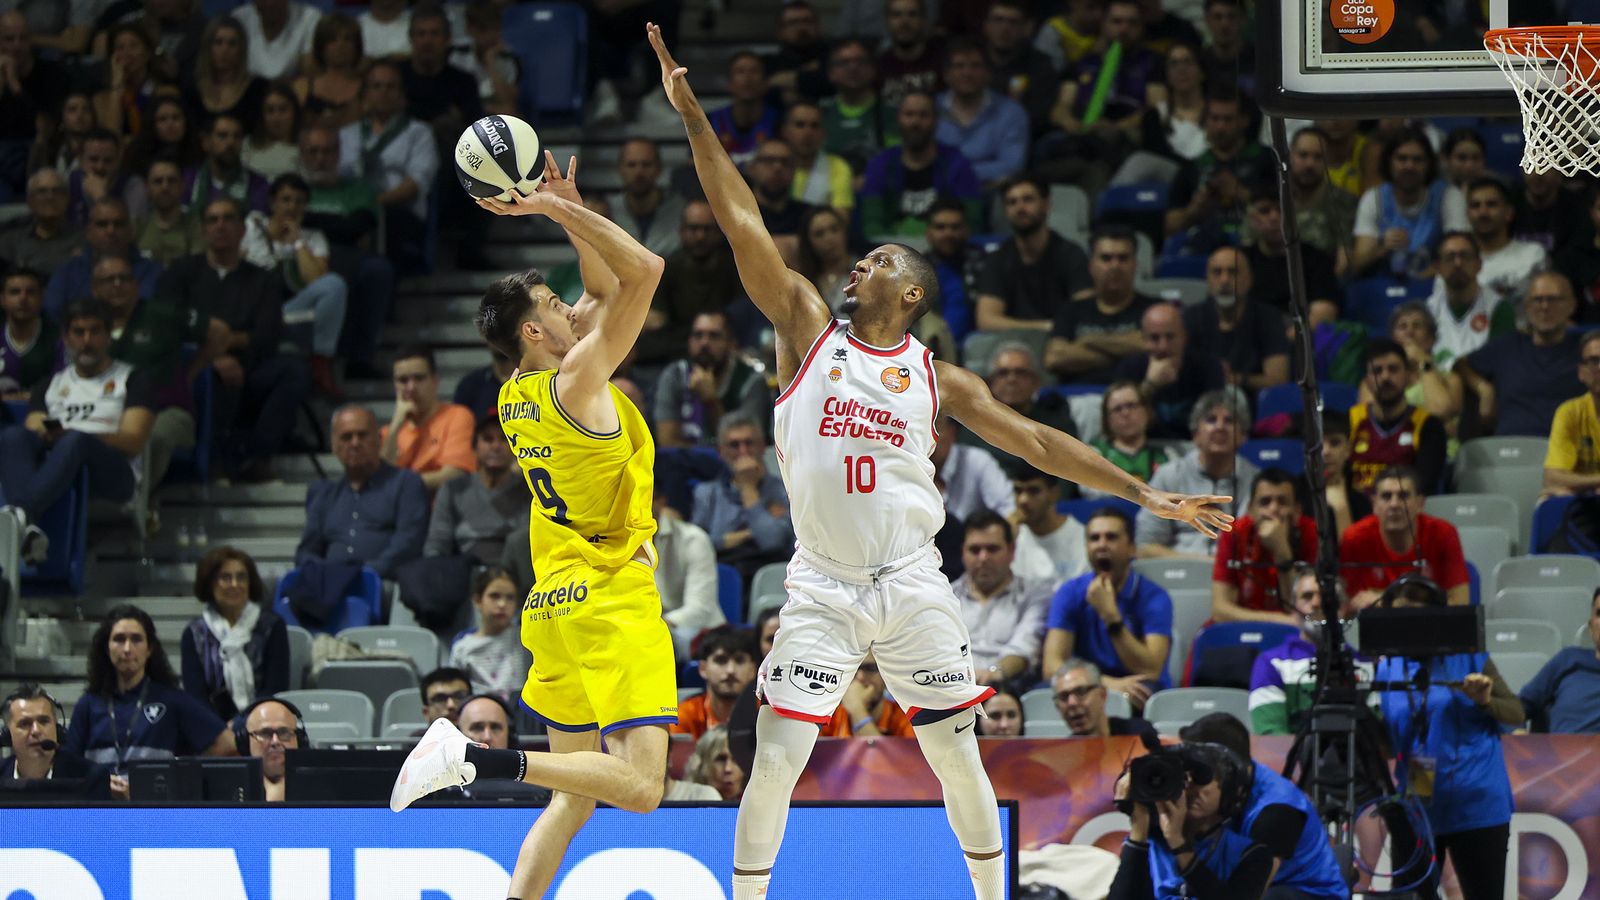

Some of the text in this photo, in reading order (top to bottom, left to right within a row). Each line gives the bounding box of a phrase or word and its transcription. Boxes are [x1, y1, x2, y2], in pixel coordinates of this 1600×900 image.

[1341, 4, 1374, 15] Copa
[1357, 16, 1378, 27] Rey
[466, 152, 484, 171] 2024
[823, 397, 908, 430] Cultura del
[819, 417, 905, 448] Esfuerzo
[844, 456, 876, 494] 10
[528, 467, 573, 525] 9
[529, 607, 571, 622] HOTEL ROUP
[794, 665, 838, 685] PULEVA
[912, 670, 964, 685] Midea
